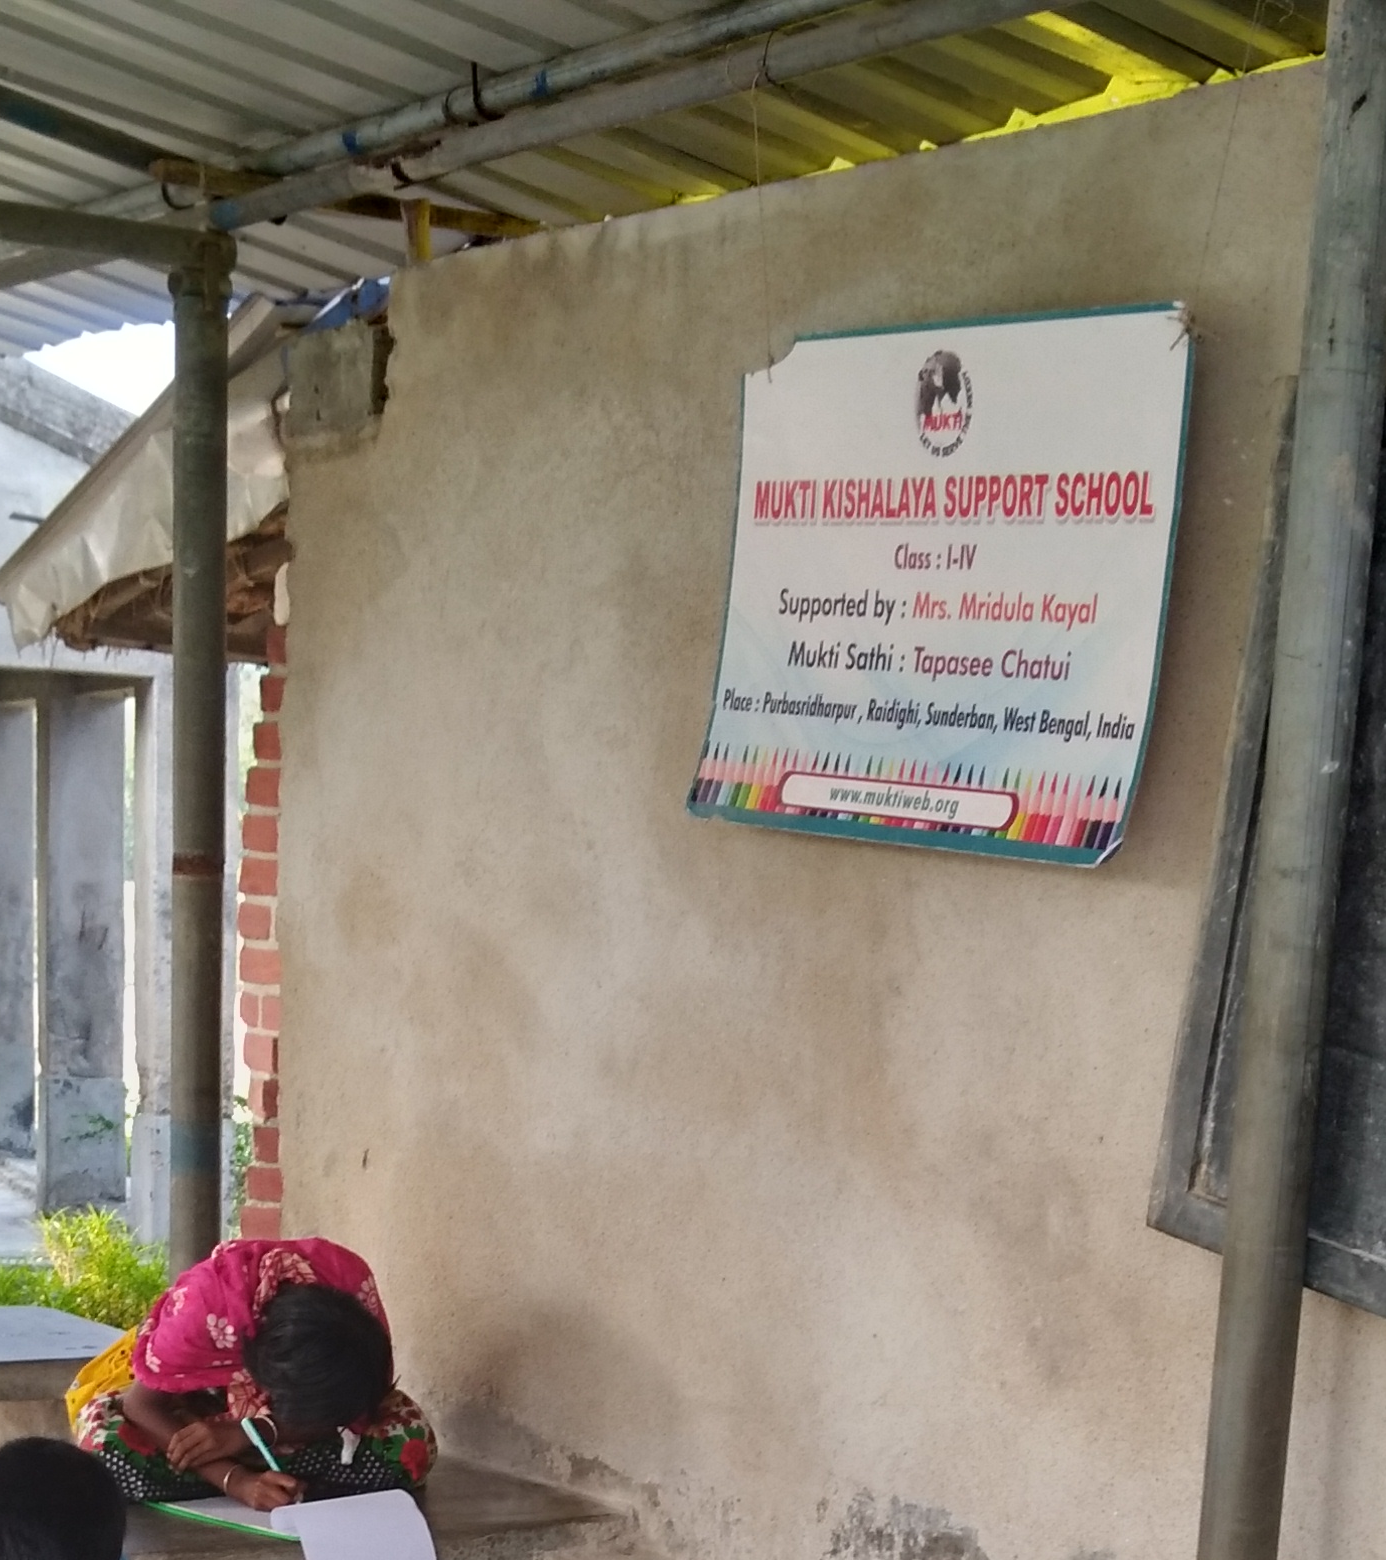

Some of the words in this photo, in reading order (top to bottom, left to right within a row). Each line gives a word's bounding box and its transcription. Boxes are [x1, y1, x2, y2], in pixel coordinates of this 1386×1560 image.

[753, 480, 816, 520] MUKTI
[822, 477, 937, 518] KISHALAYA
[943, 474, 1050, 518] SUPPORT
[1054, 471, 1154, 517] SCHOOL
[894, 543, 932, 571] Class
[946, 544, 977, 571] I-IV
[778, 588, 869, 621] Supported
[873, 590, 897, 626] by
[913, 592, 952, 622] Mrs.
[959, 592, 1034, 624] Mridula
[1040, 593, 1098, 632] Kayal
[788, 641, 839, 669] Mukti
[845, 643, 894, 672] Sathi
[913, 646, 993, 682] Tapasee
[1001, 649, 1072, 682] Chatui
[722, 688, 754, 712] Place
[763, 691, 857, 725] Purbasridharpur
[867, 697, 921, 731] Raidighi,
[925, 702, 999, 734] Sunderban,
[1003, 706, 1037, 734] West
[1039, 709, 1092, 743] Bengal,
[1096, 713, 1135, 742] India
[829, 785, 960, 820] www.muktiweb.org
